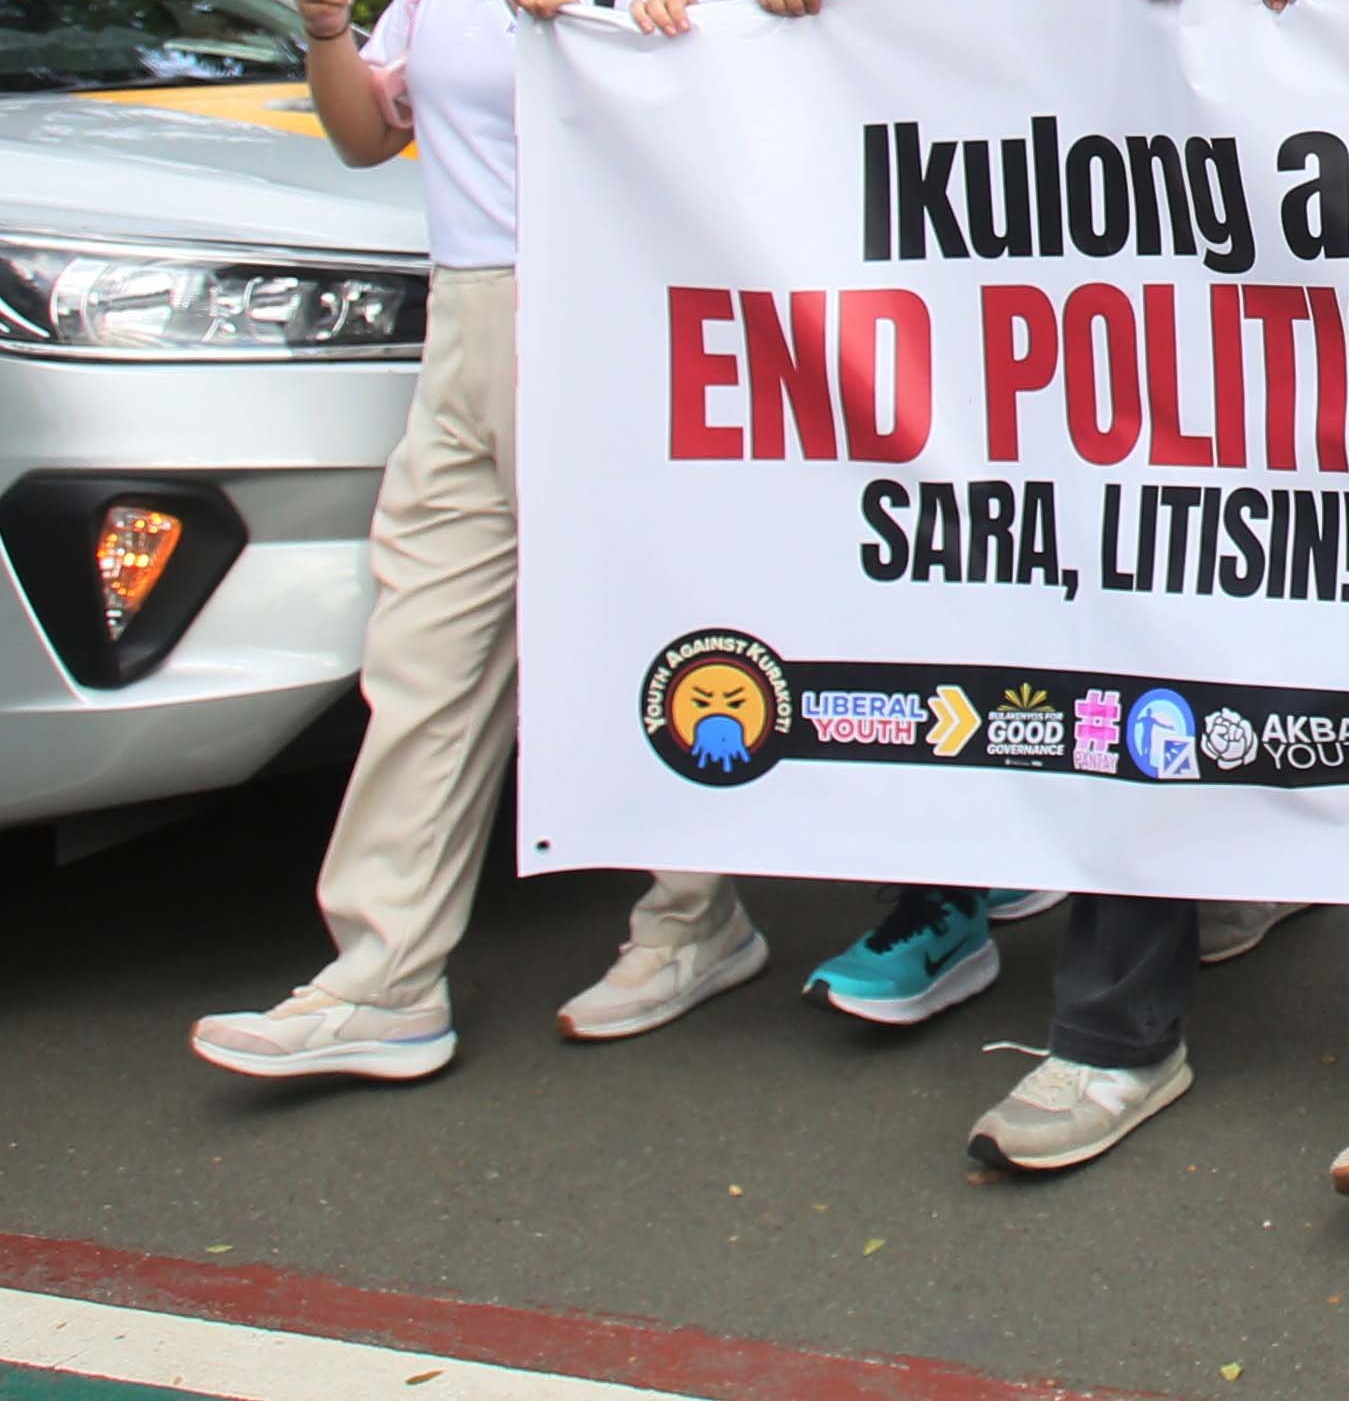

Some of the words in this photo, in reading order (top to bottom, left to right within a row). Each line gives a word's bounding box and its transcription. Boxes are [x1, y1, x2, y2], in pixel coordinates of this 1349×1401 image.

[863, 116, 1257, 274] Ikulong
[668, 285, 934, 464] END
[861, 478, 1080, 602] SARA,
[644, 666, 672, 734] YOUTH
[665, 636, 749, 669] AGAINST
[802, 691, 928, 722] LIBERAL
[812, 717, 917, 745] YOUTH
[986, 744, 1065, 757] GOVERNANCE
[987, 720, 1064, 744] GOOD
